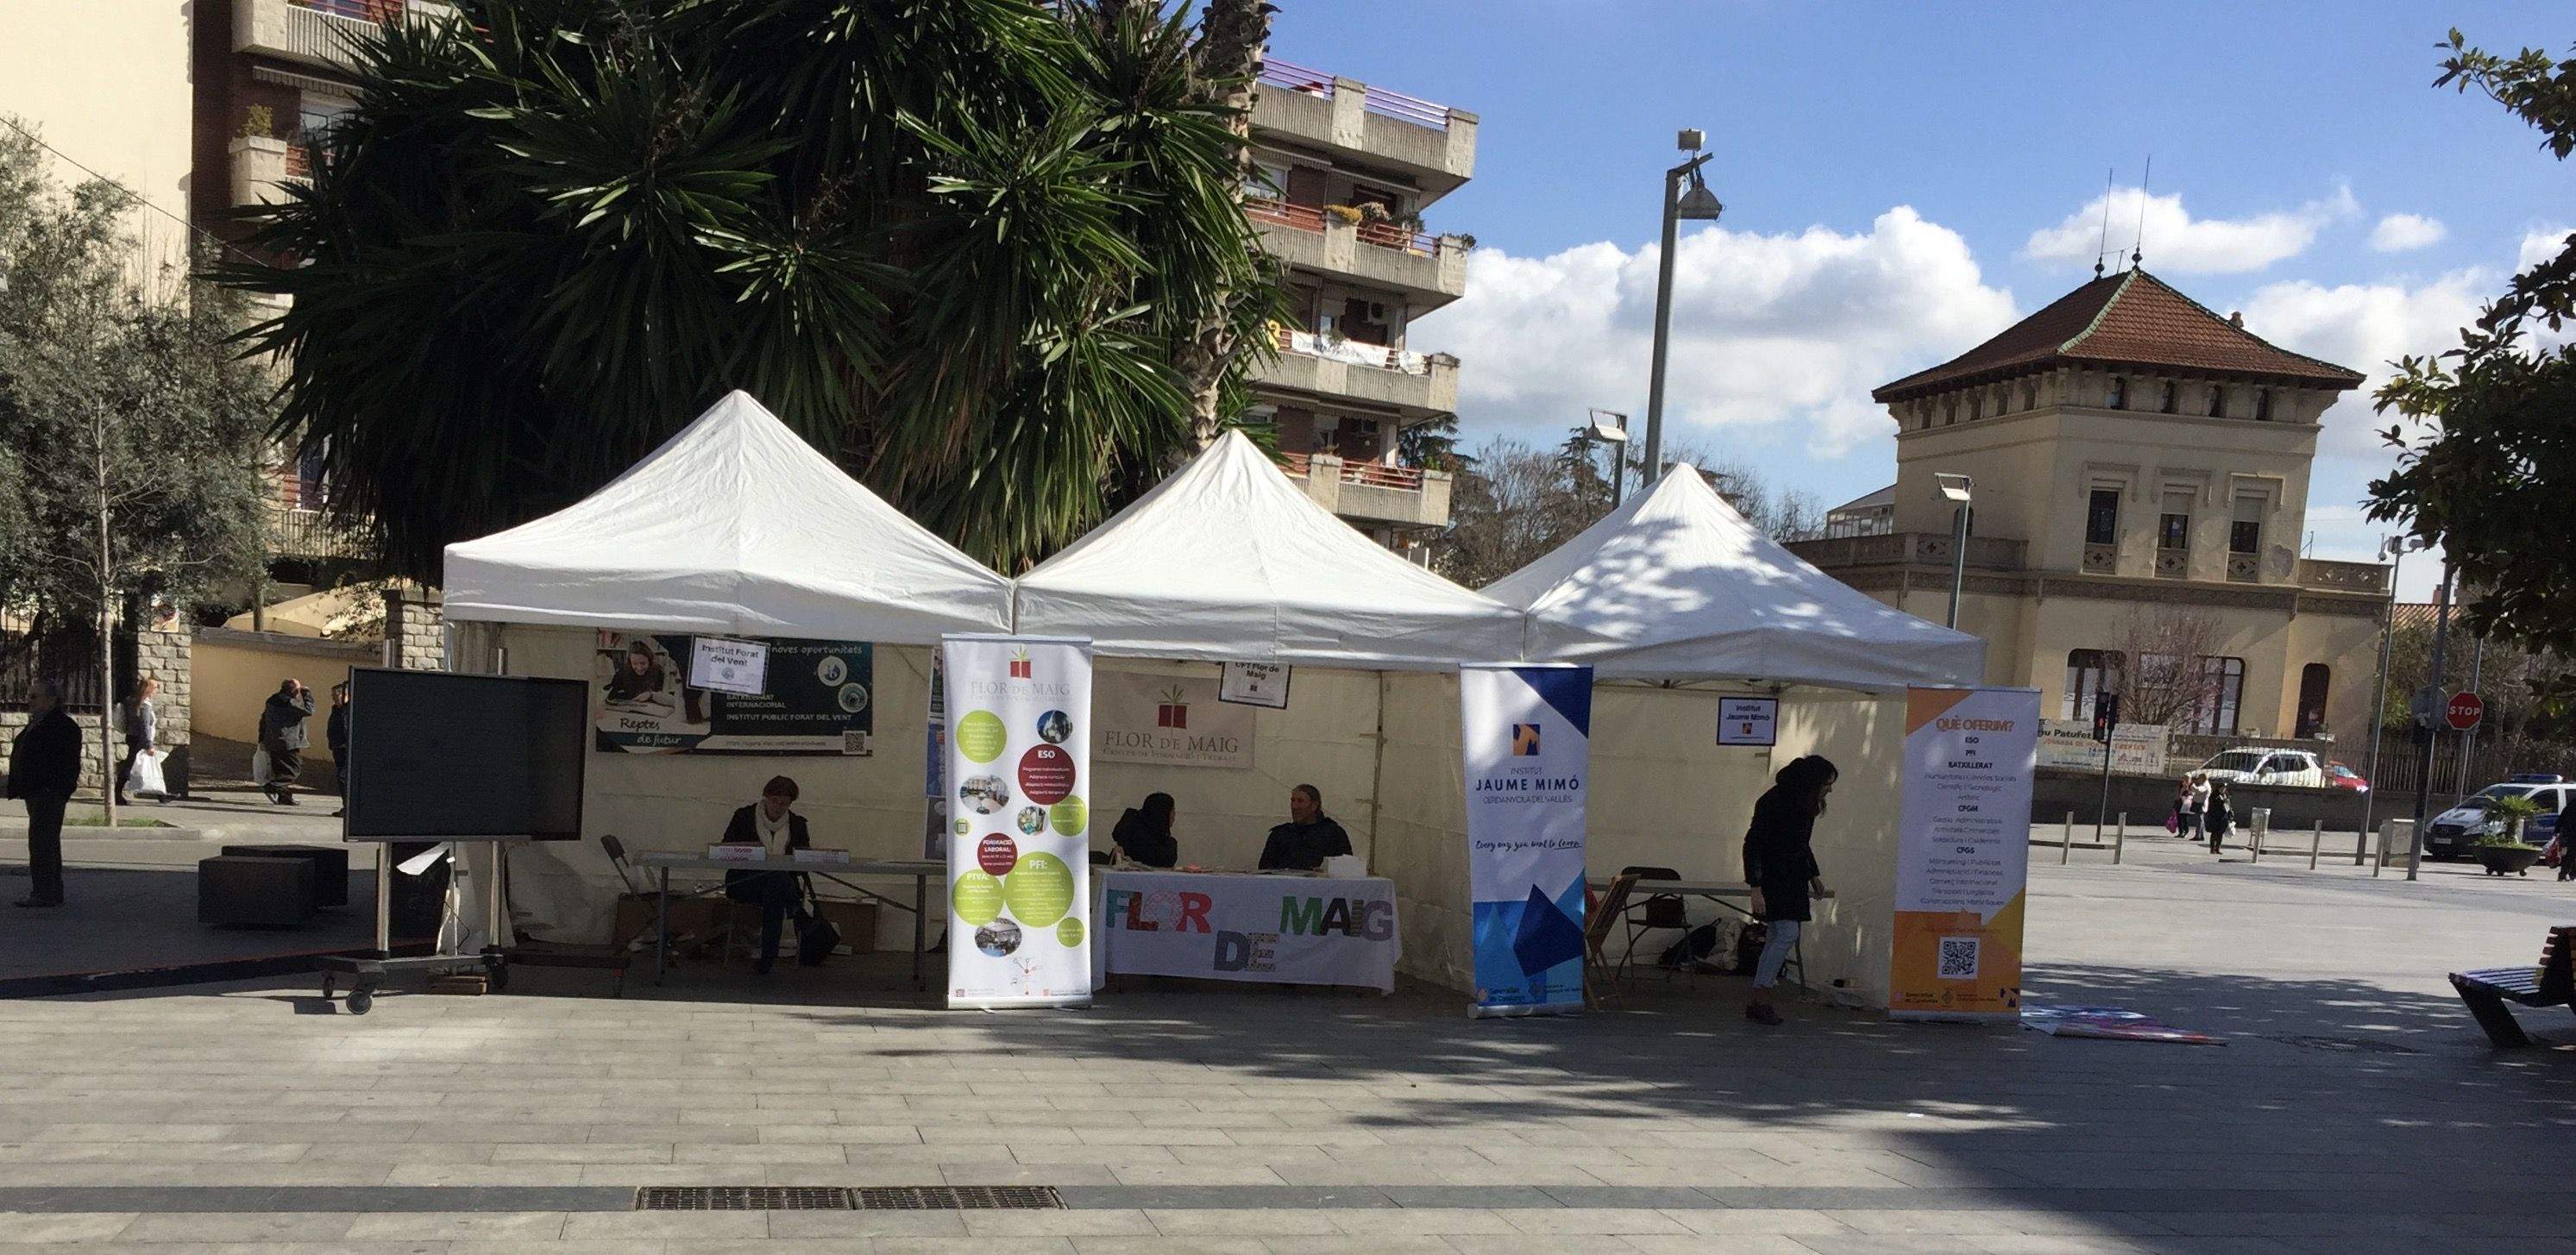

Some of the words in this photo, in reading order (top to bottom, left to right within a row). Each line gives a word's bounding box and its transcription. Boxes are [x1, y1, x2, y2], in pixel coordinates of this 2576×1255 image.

[702, 644, 734, 656] Institut
[735, 649, 759, 659] Forat
[771, 646, 799, 655] noves
[801, 646, 863, 657] oportunitats
[711, 655, 726, 663] del
[727, 657, 748, 667] Vent
[1252, 662, 1268, 671] Flor
[1246, 669, 1266, 681] Maig
[971, 681, 1008, 695] FLOR
[1032, 682, 1071, 697] MAIG
[1735, 704, 1762, 712] Institut
[2448, 706, 2481, 717] STOP
[726, 713, 761, 722] INSTITUT
[790, 713, 814, 722] FORAT
[815, 713, 831, 722] DEL
[832, 713, 852, 722] VENT
[1725, 712, 1750, 721] Jaume
[619, 717, 661, 732] Reptes
[1935, 715, 1961, 732] QUÈ
[1963, 718, 2015, 732] OFERIM?
[2053, 729, 2092, 740] Patufet
[637, 734, 651, 745] de
[652, 734, 682, 747] futur
[1104, 731, 1154, 749] FLOR
[1159, 738, 1181, 750] DE
[1187, 736, 1239, 754] MAIG
[1037, 750, 1056, 760] ESO
[1510, 766, 1543, 775] INSTITUT
[1947, 761, 1994, 769] BATXILLERAT
[1475, 778, 1529, 791] JAUME
[1535, 775, 1580, 791] MIMÓ
[1482, 795, 1533, 805] CERDANYOLA
[1532, 795, 1545, 804] DEL
[1957, 804, 1979, 813] CFGM
[1475, 840, 1496, 852] Every
[1513, 841, 1529, 852] you
[1530, 839, 1549, 850] want
[1956, 846, 1976, 855] CFGS
[1106, 888, 1214, 934] FLOR
[1279, 895, 1393, 942] MAIG
[1213, 930, 1279, 973] DE
